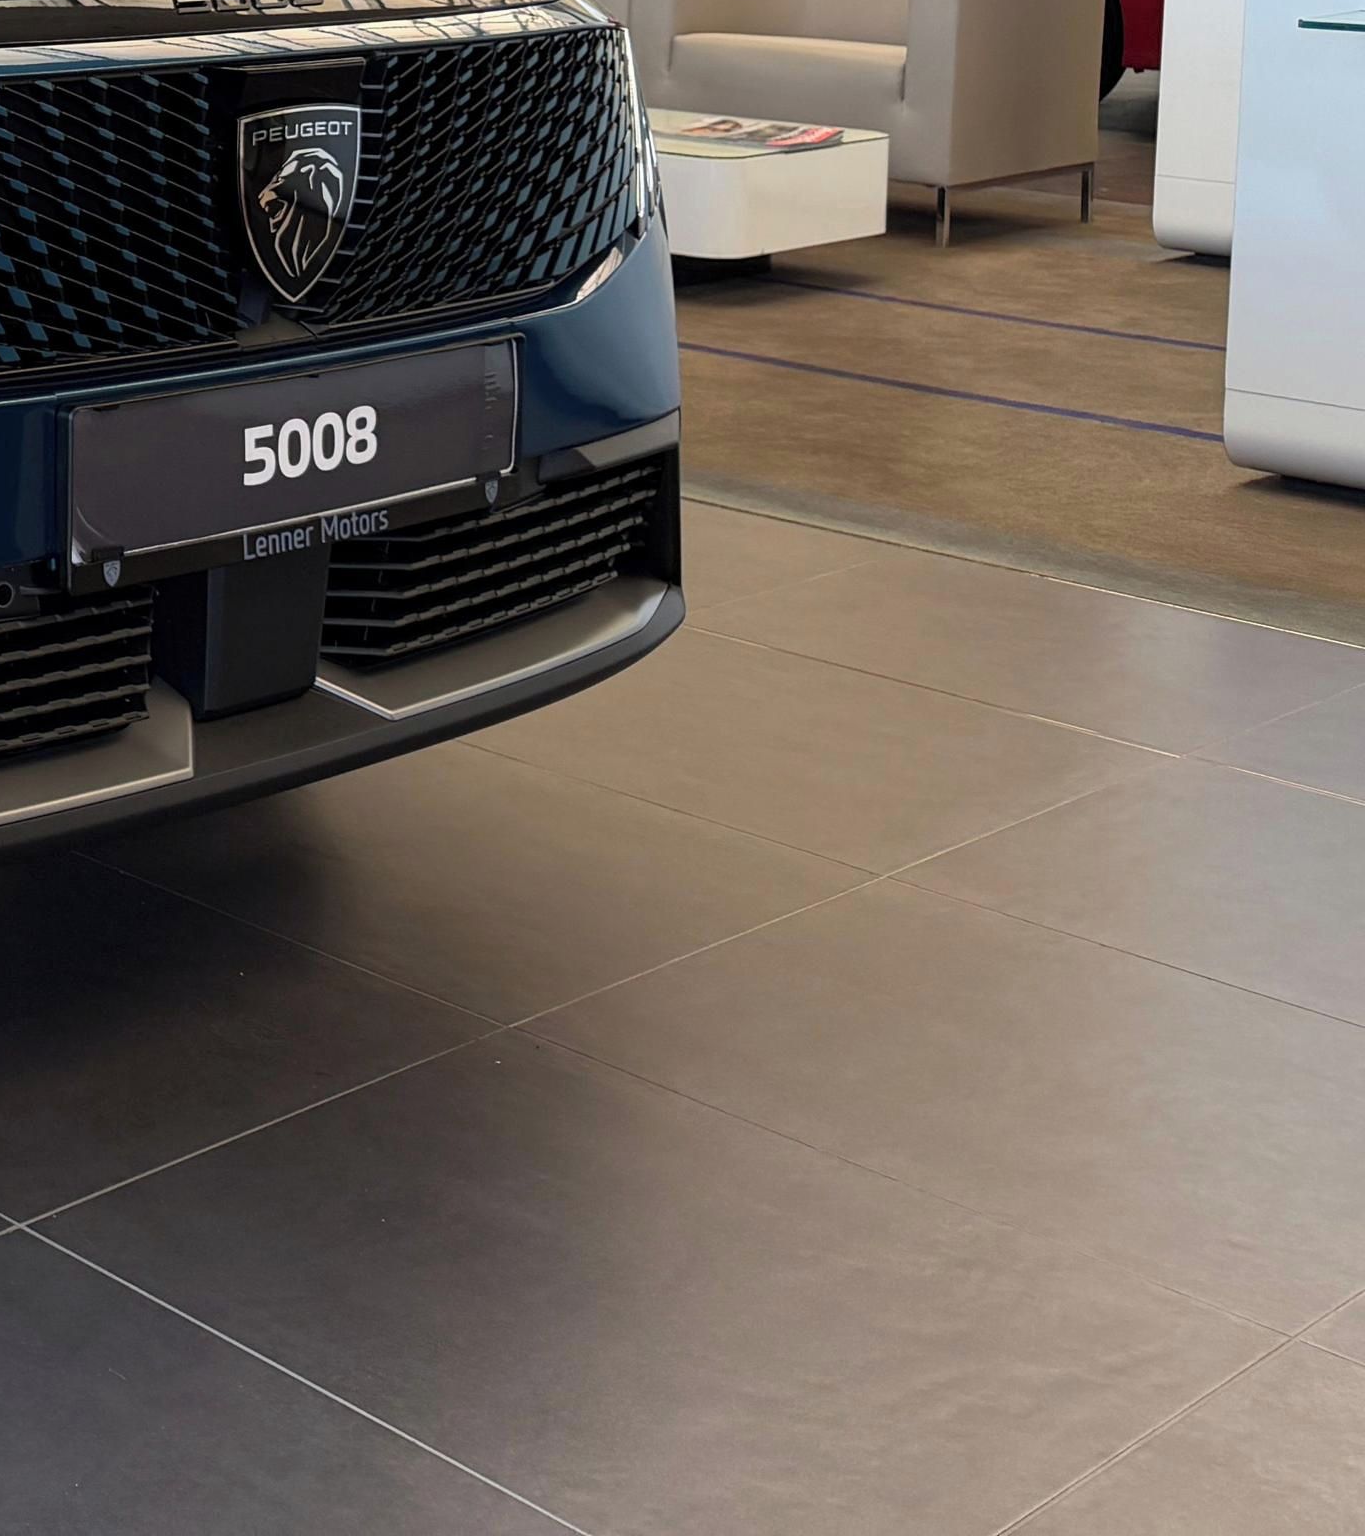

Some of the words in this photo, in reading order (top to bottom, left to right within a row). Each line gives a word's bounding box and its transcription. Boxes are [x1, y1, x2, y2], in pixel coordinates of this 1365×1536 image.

[252, 120, 353, 146] PEUGEOT
[243, 405, 378, 487] 5008
[243, 523, 314, 561] Lenner
[321, 508, 389, 547] Motors
